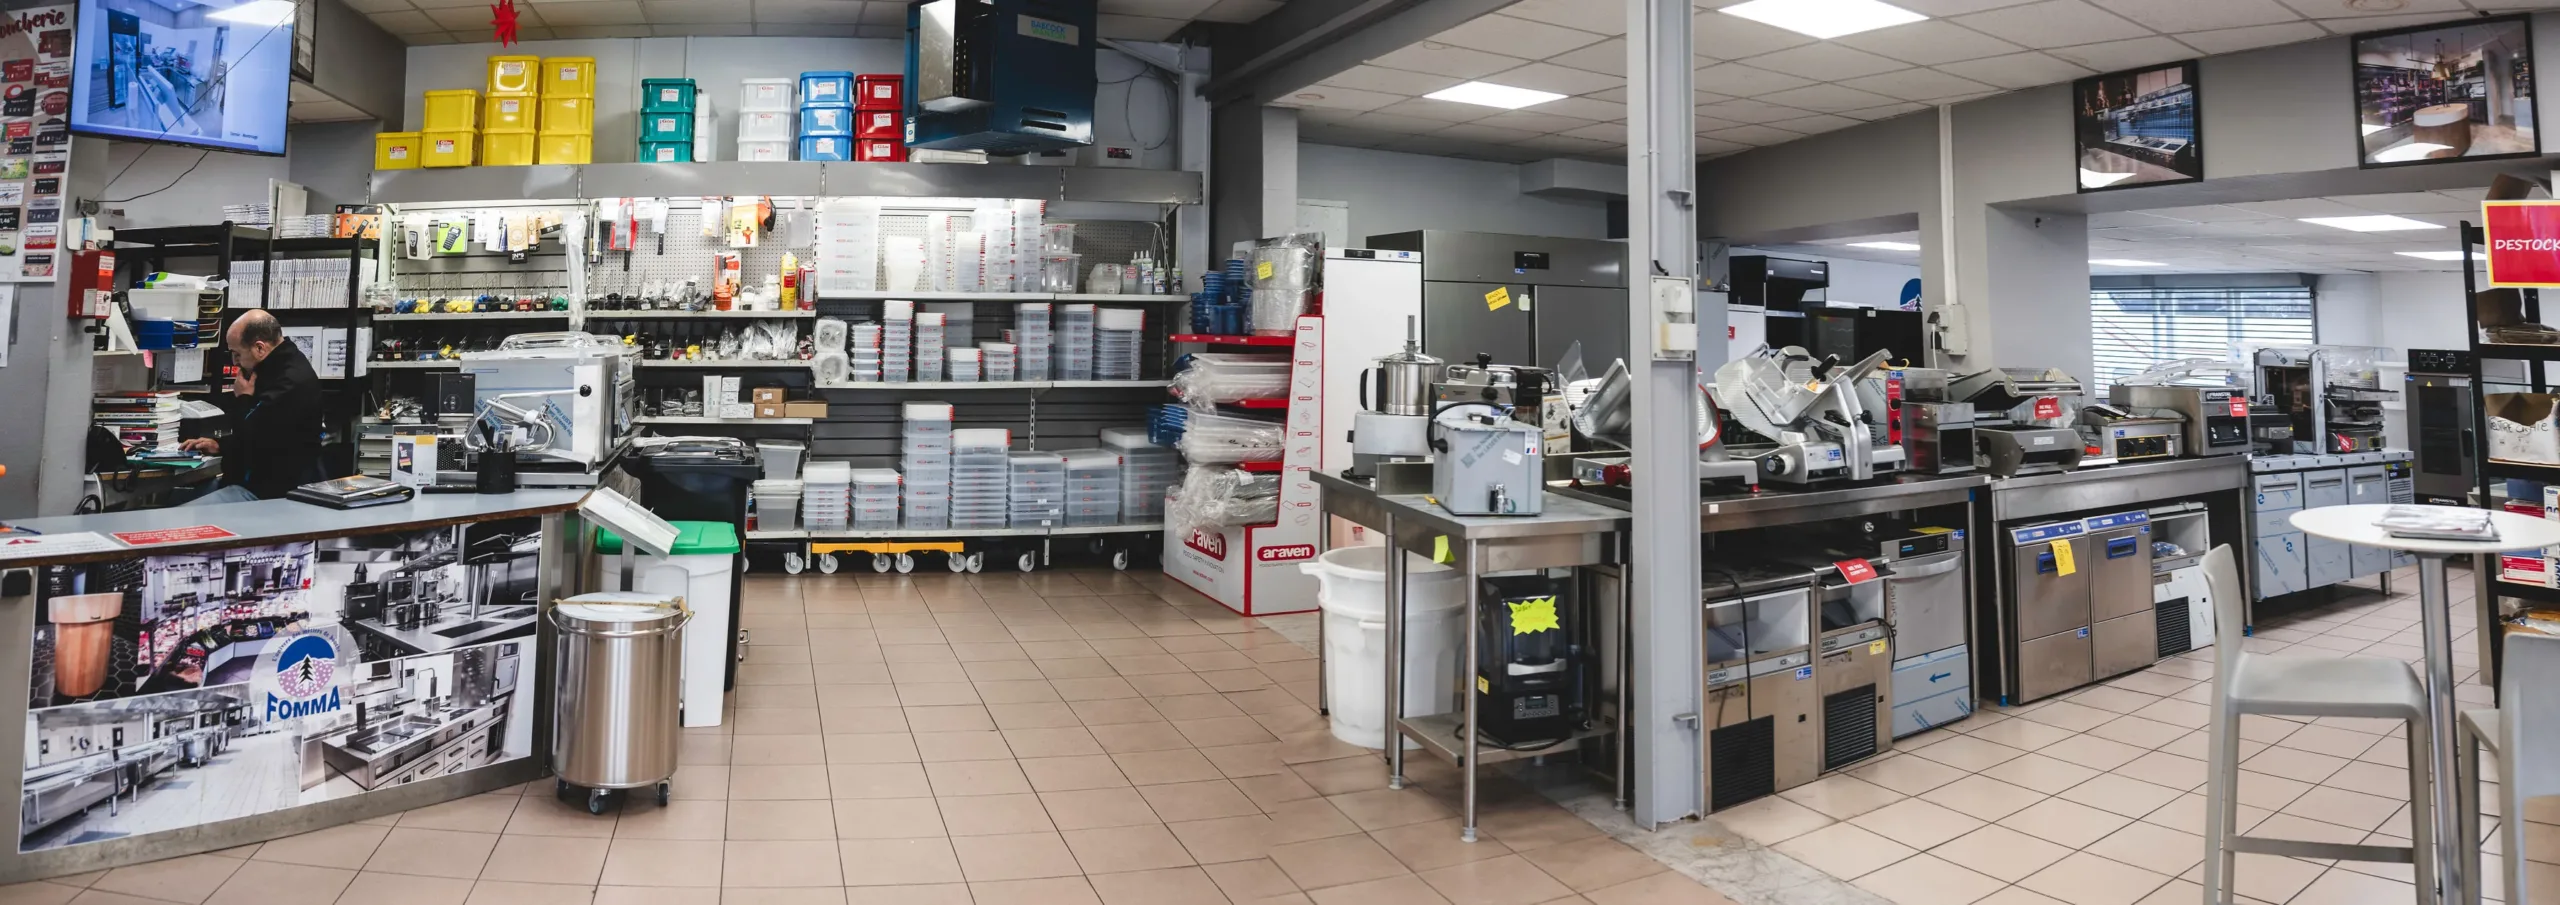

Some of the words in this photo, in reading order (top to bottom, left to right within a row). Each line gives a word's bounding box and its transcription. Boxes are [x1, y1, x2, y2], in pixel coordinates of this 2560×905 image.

[1031, 20, 1066, 34] BABCOCK
[1262, 546, 1310, 559] araven
[266, 685, 340, 722] FOMMA
